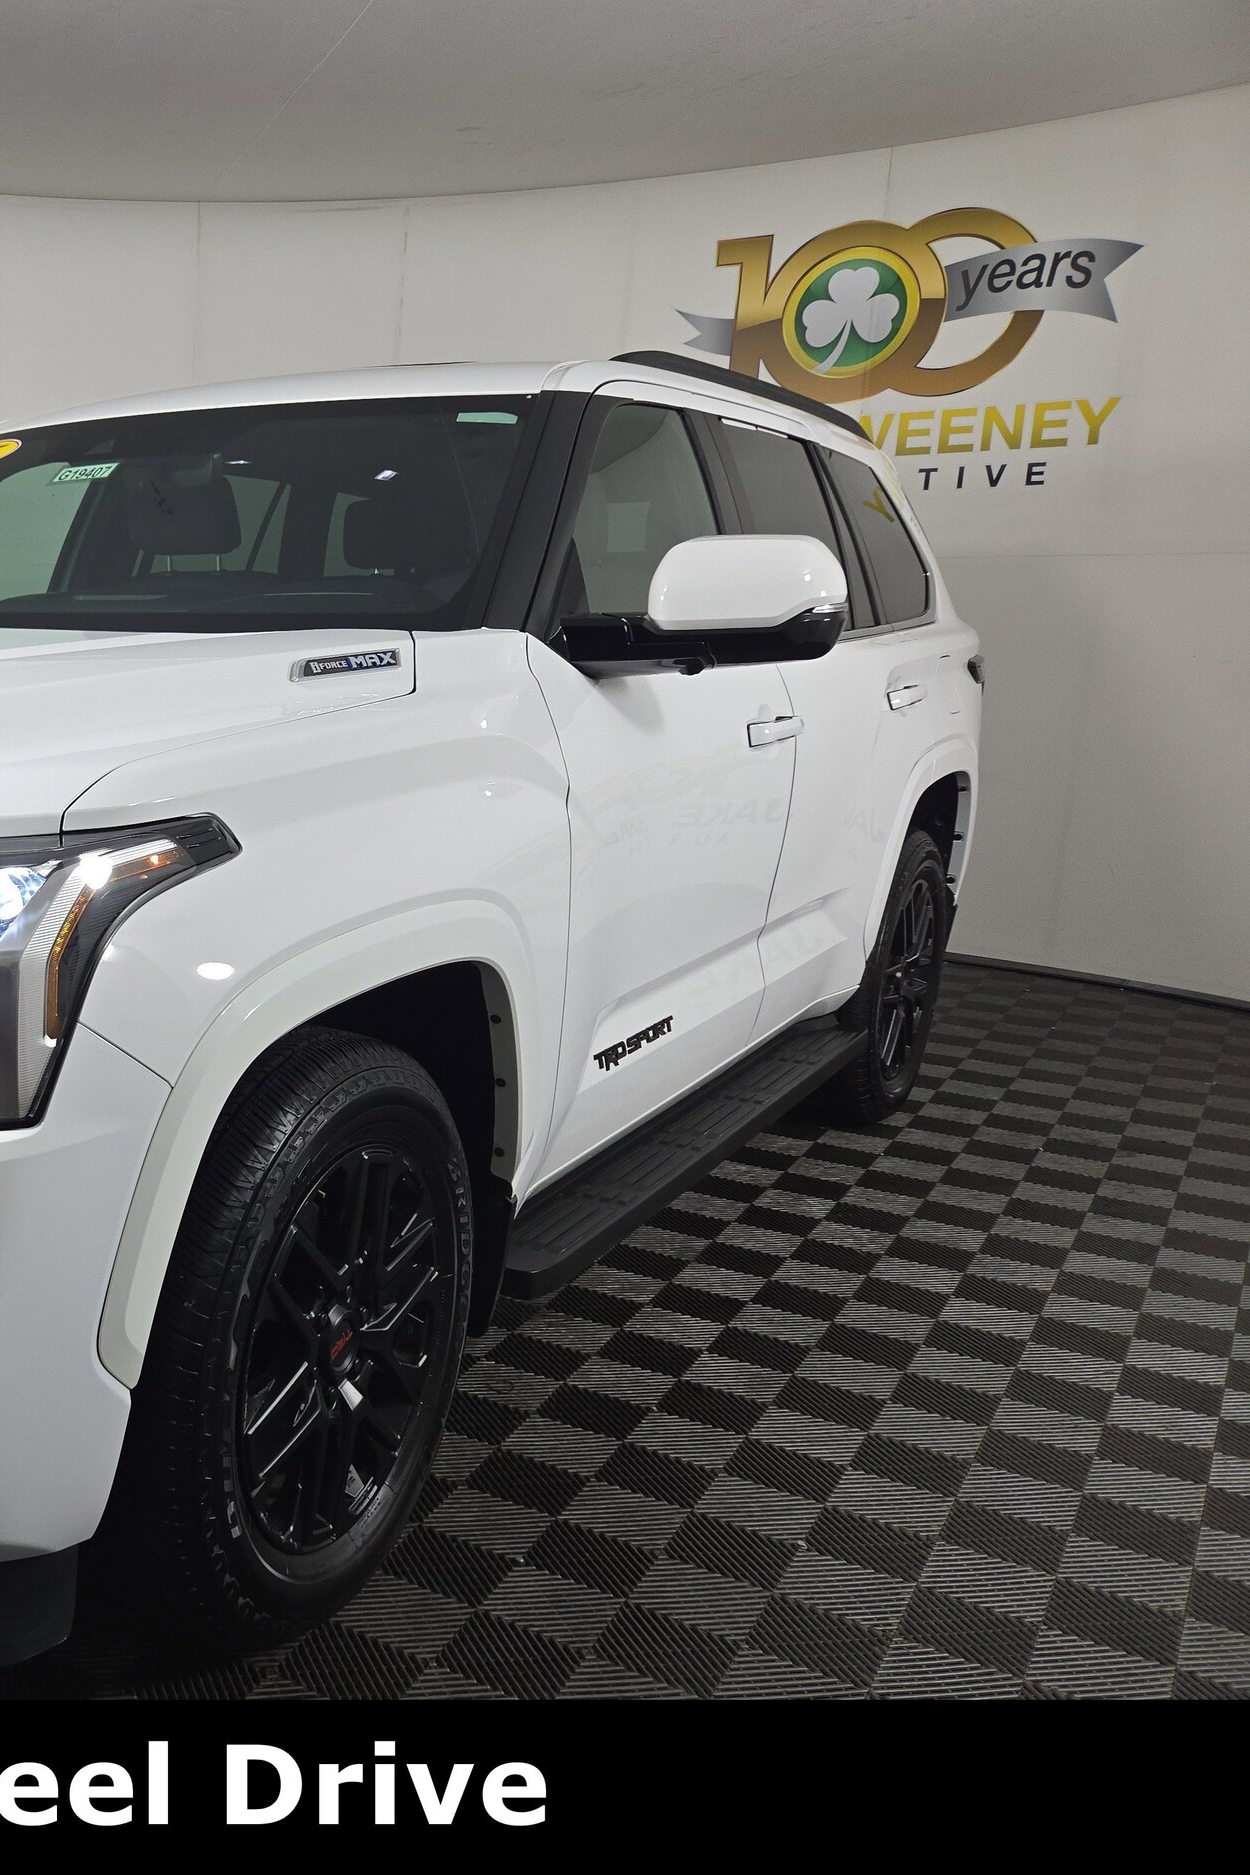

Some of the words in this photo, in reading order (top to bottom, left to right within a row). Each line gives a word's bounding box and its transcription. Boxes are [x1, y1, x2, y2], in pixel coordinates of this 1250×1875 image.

[956, 249, 1097, 312] years
[58, 466, 112, 481] G19407
[350, 652, 396, 668] MAX
[593, 1041, 627, 1071] TRD
[626, 1015, 674, 1055] SPORT
